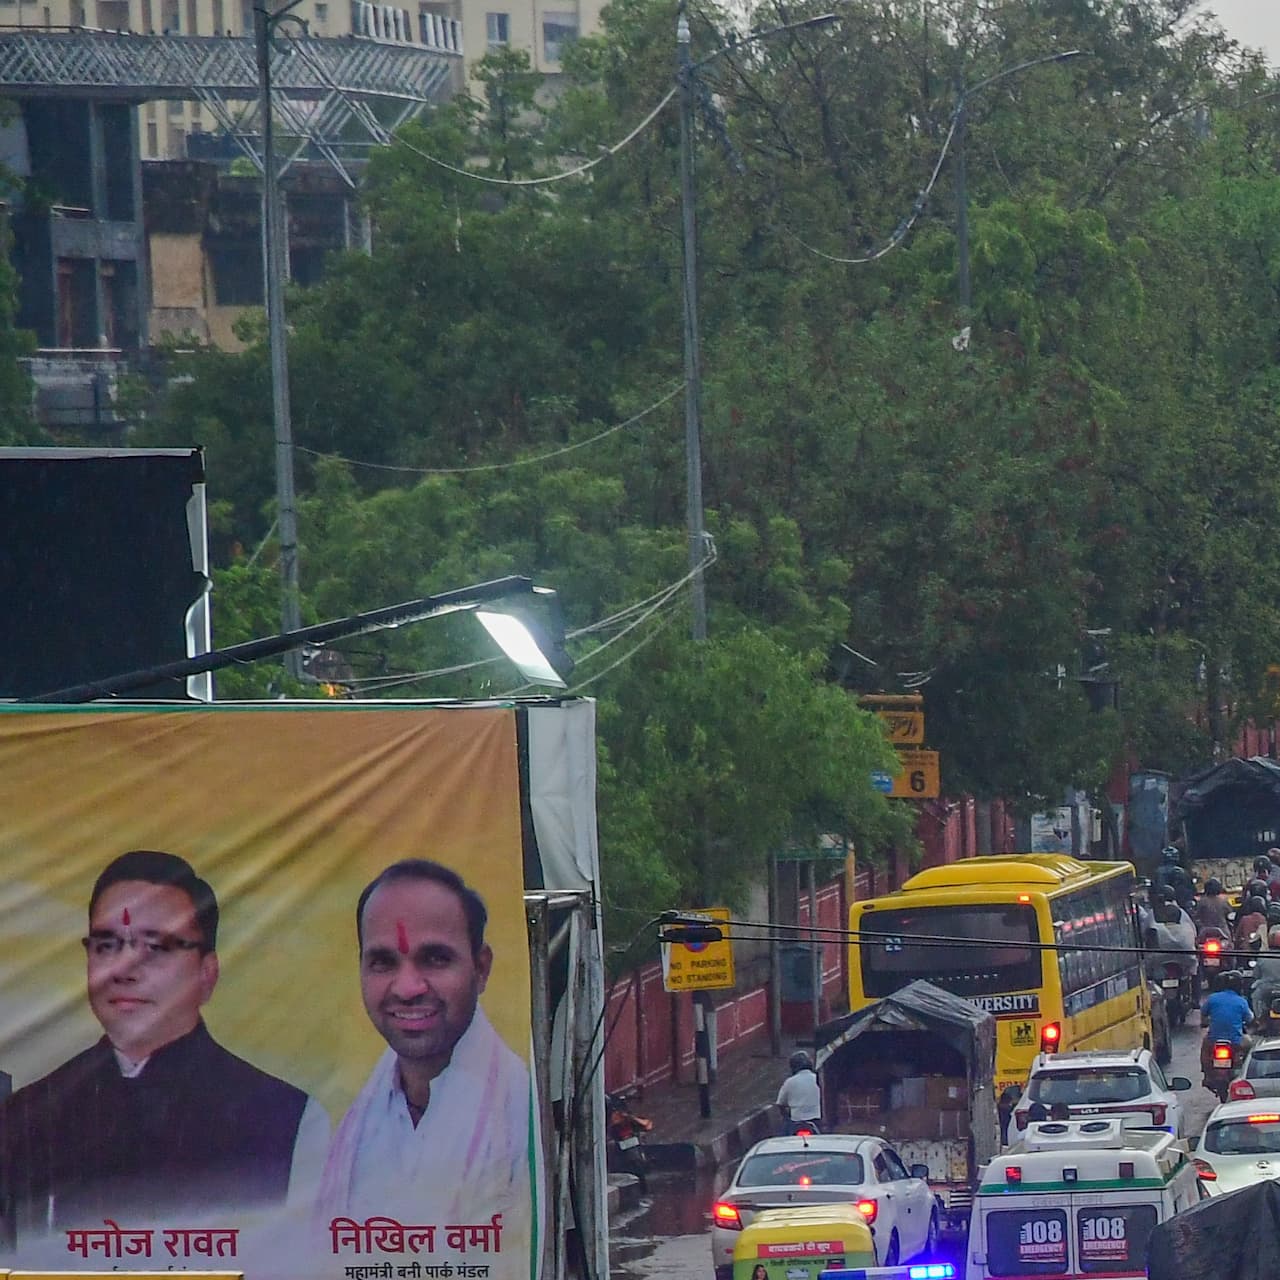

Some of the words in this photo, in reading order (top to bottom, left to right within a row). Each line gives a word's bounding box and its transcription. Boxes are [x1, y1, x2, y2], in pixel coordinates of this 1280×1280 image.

[910, 771, 925, 793] 6
[670, 961, 682, 970] NO
[690, 959, 728, 969] PARKING
[671, 975, 683, 983] NO
[686, 972, 728, 983] STANDING
[66, 1218, 154, 1258] मनोज
[163, 1229, 240, 1257] रावत
[329, 1216, 436, 1254] निखिल
[445, 1214, 503, 1253] वर्मा
[1022, 1220, 1062, 1244] 108
[1084, 1217, 1125, 1240] 108
[1082, 1240, 1126, 1250] EMERGENCY
[345, 1262, 393, 1280] महामंत्री
[397, 1261, 421, 1278] बनी
[426, 1261, 453, 1278] पार्क
[457, 1262, 490, 1278] मंडल
